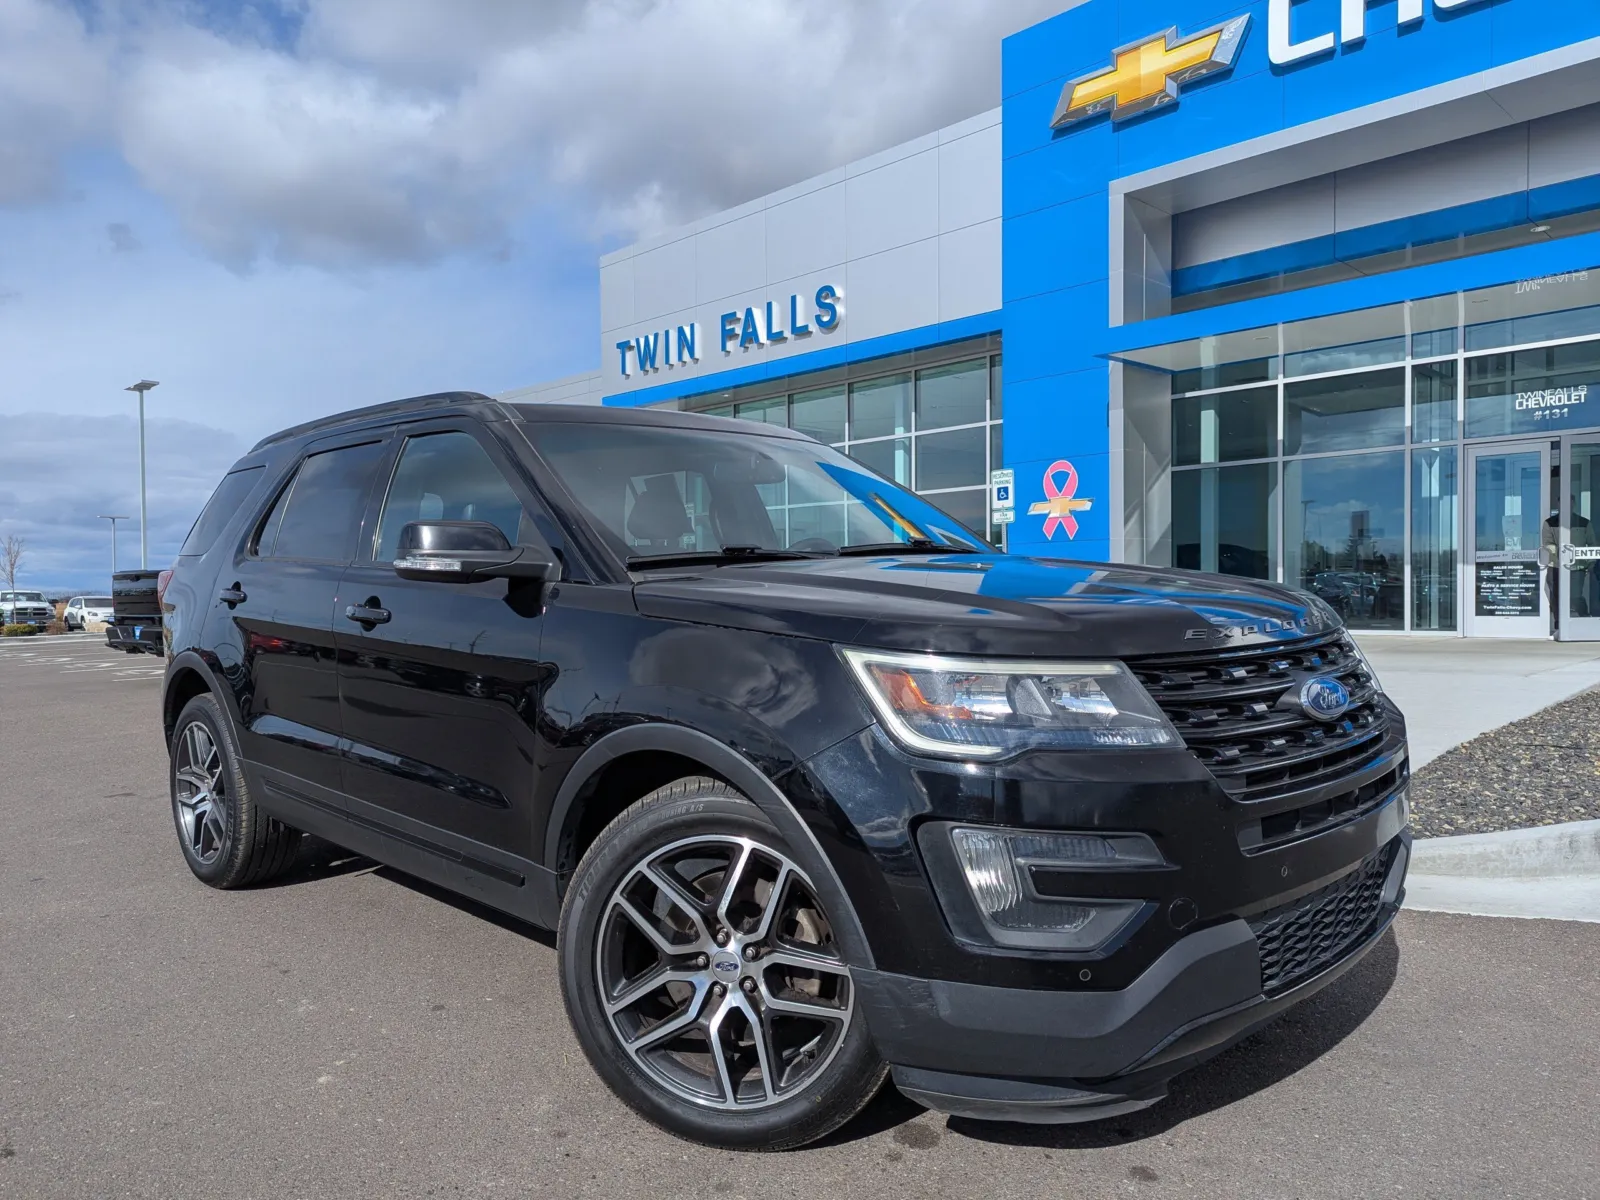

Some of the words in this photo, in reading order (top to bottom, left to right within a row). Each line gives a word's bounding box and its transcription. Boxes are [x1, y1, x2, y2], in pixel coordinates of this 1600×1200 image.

[615, 322, 698, 376] TWIN
[720, 284, 842, 353] FALLS
[1515, 392, 1587, 410] CHEVROLET
[1533, 408, 1569, 421] #131
[1184, 611, 1331, 640] EXPLORER
